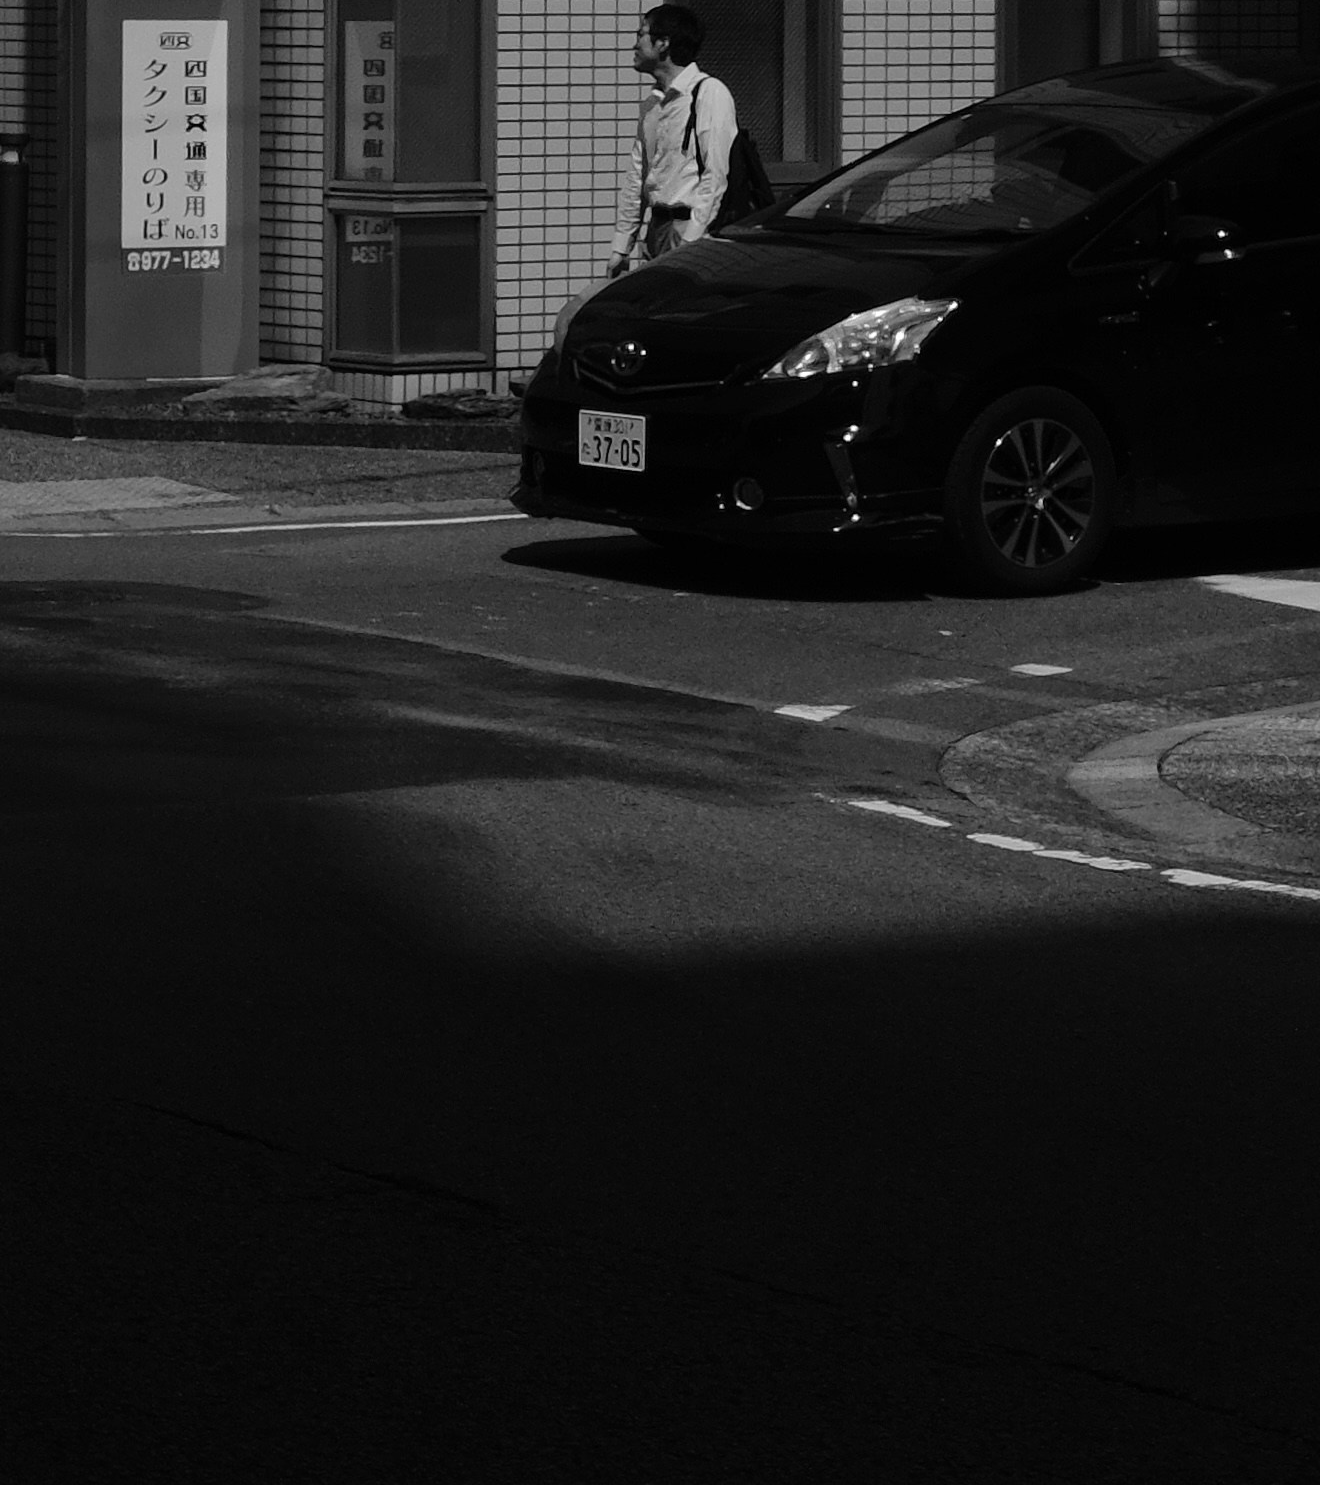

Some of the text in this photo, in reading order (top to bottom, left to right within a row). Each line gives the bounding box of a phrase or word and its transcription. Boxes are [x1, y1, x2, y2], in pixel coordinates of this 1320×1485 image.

[142, 59, 170, 241] タクシーのりば
[184, 59, 208, 218] 四国交通専用
[175, 224, 219, 240] No.13
[593, 436, 641, 467] 37-05
